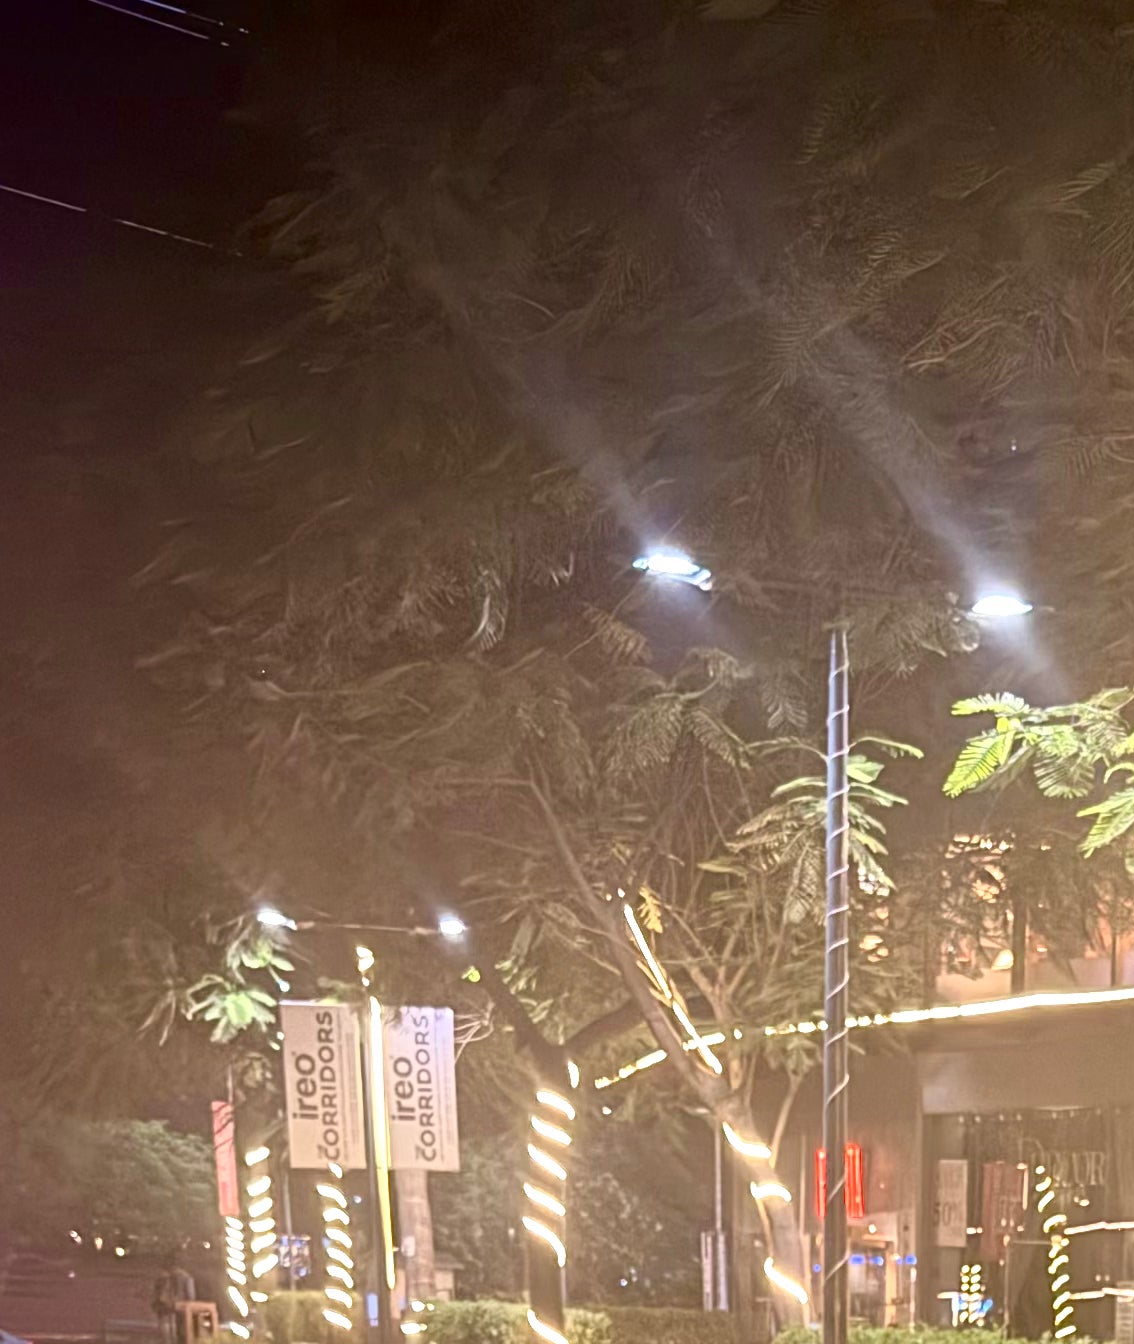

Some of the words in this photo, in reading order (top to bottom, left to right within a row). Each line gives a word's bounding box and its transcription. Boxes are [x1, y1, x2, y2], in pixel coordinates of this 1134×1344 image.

[292, 1053, 319, 1119] ireo
[316, 1010, 340, 1160] CORRIDORS
[391, 1057, 416, 1121] ireo
[413, 1015, 437, 1161] CORRIDORS
